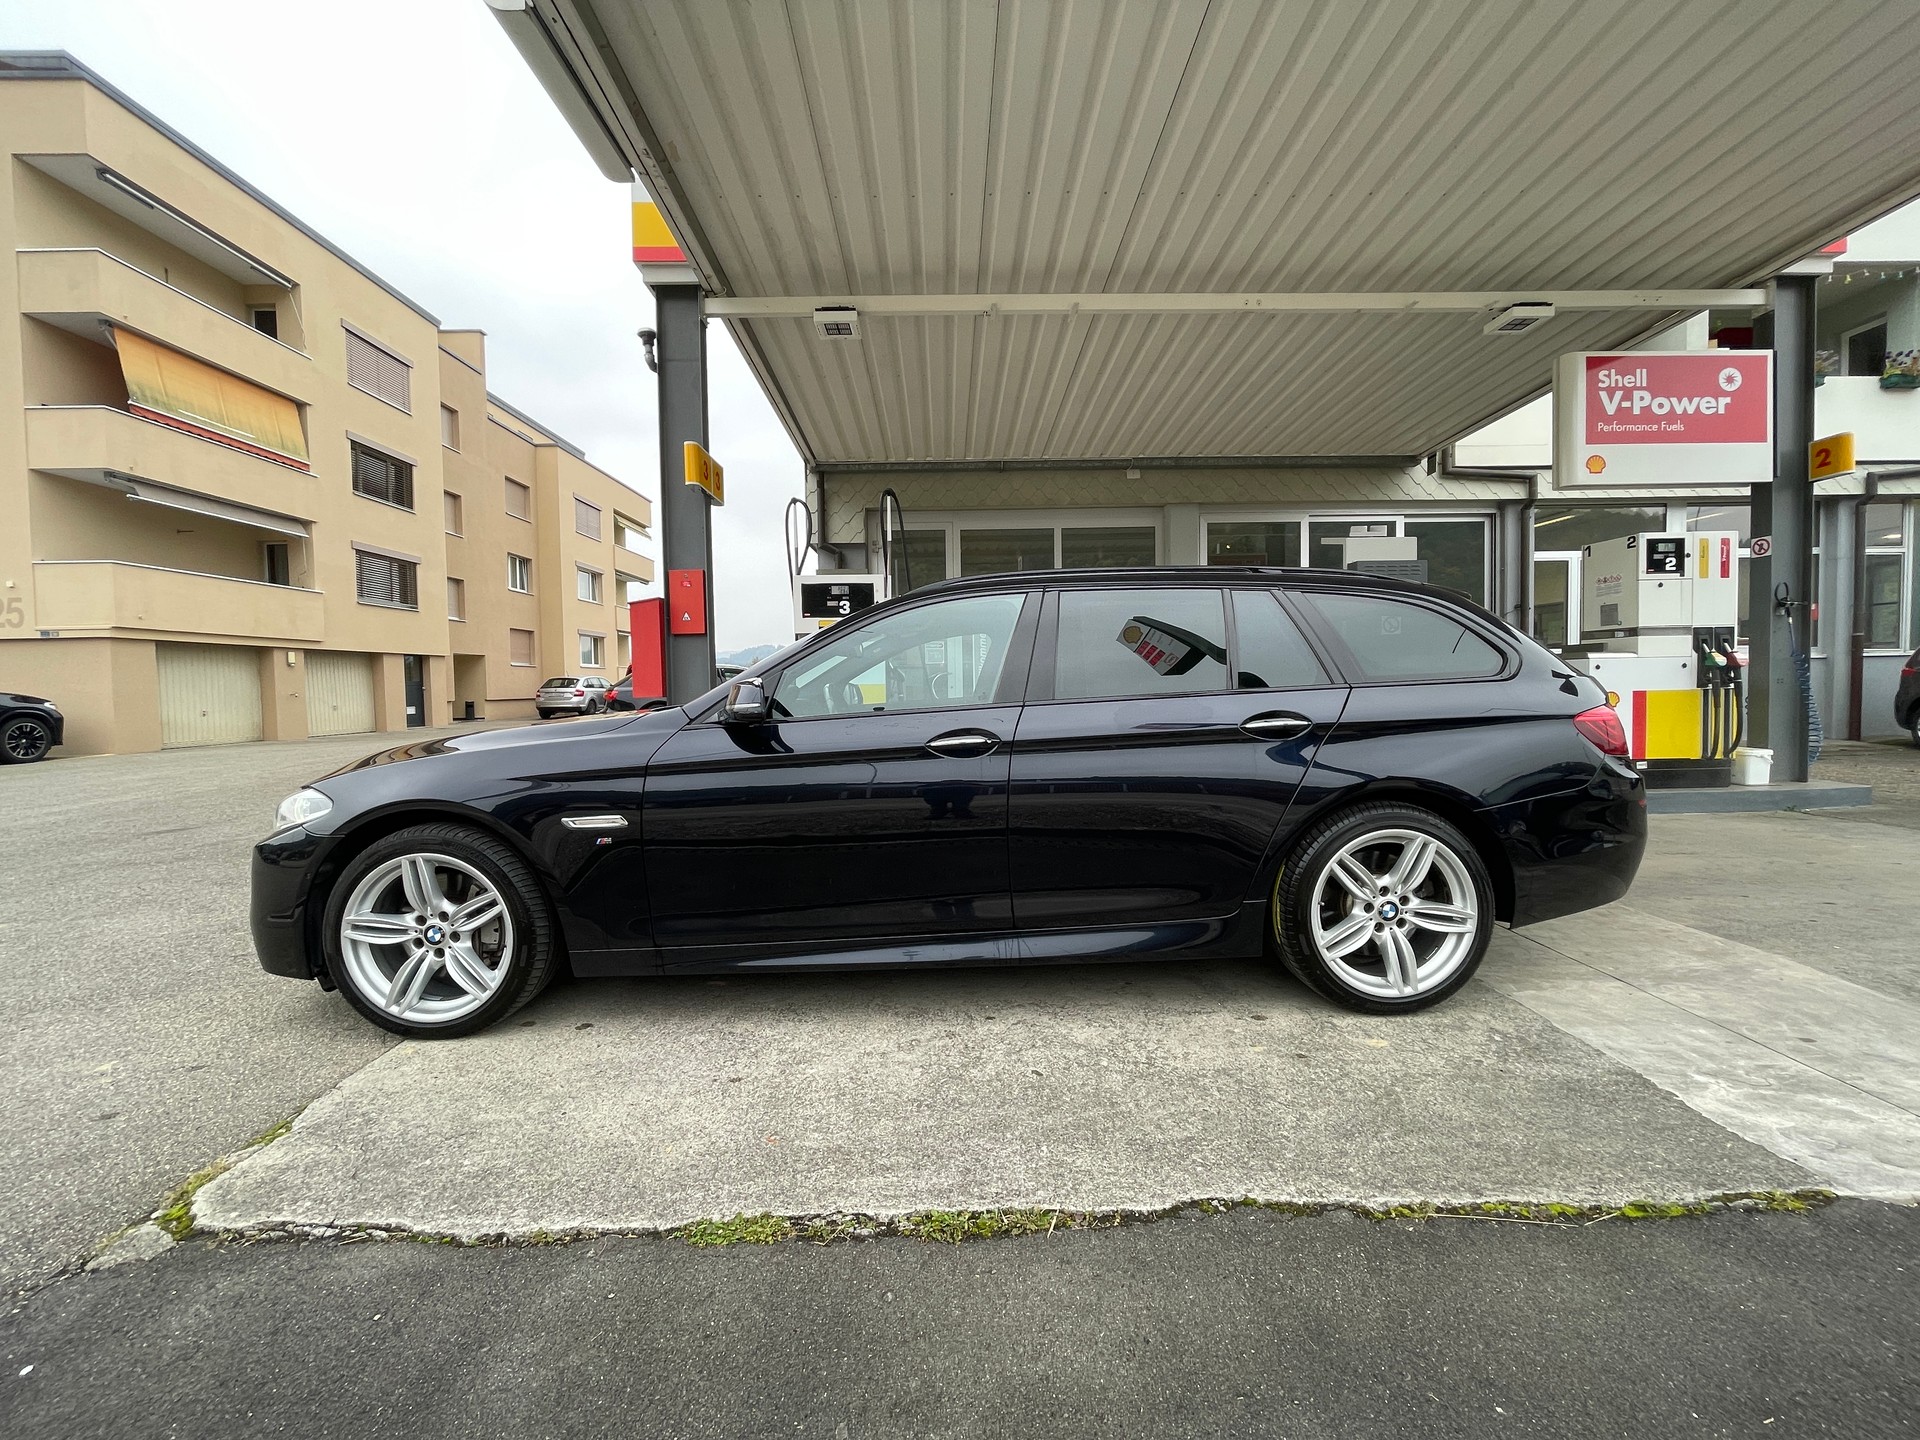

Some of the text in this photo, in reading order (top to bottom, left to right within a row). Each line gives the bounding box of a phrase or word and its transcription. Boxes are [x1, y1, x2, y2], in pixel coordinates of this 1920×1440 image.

[1598, 369, 1647, 388] Shell
[1599, 390, 1732, 415] V-Power
[1598, 420, 1685, 432] Performance Fuels
[1815, 448, 1831, 469] 2
[703, 459, 709, 481] 3
[715, 471, 721, 491] 3
[1584, 545, 1591, 558] 1
[1627, 535, 1636, 549] 2
[1665, 557, 1676, 570] 2
[0, 597, 25, 629] 5
[839, 600, 851, 614] 3
